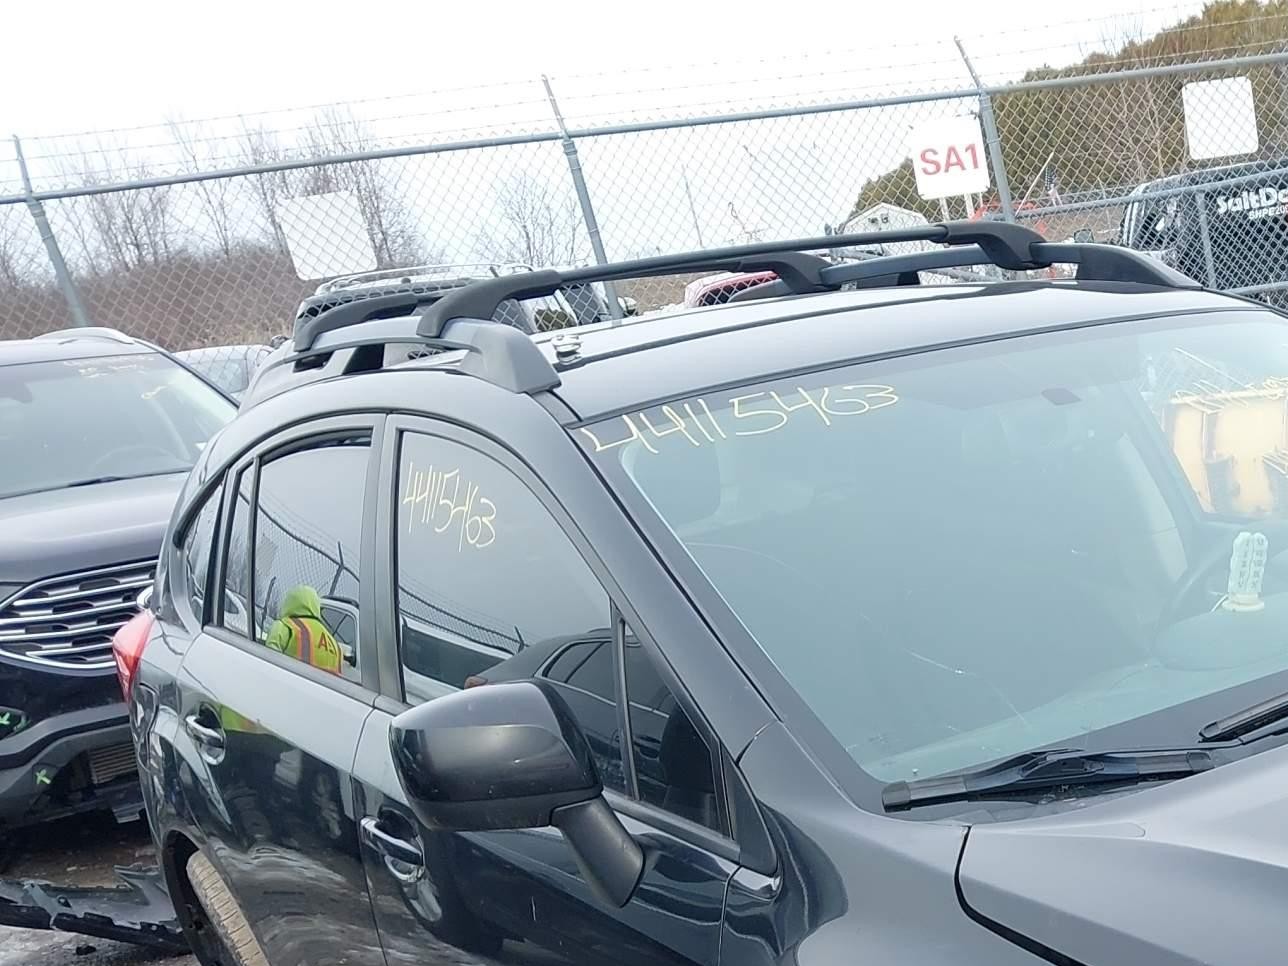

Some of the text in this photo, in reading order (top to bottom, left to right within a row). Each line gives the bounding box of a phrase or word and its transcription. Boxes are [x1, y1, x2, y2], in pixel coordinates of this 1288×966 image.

[920, 143, 979, 176] SA1
[581, 383, 899, 453] 44115463
[403, 462, 496, 552] 44115463
